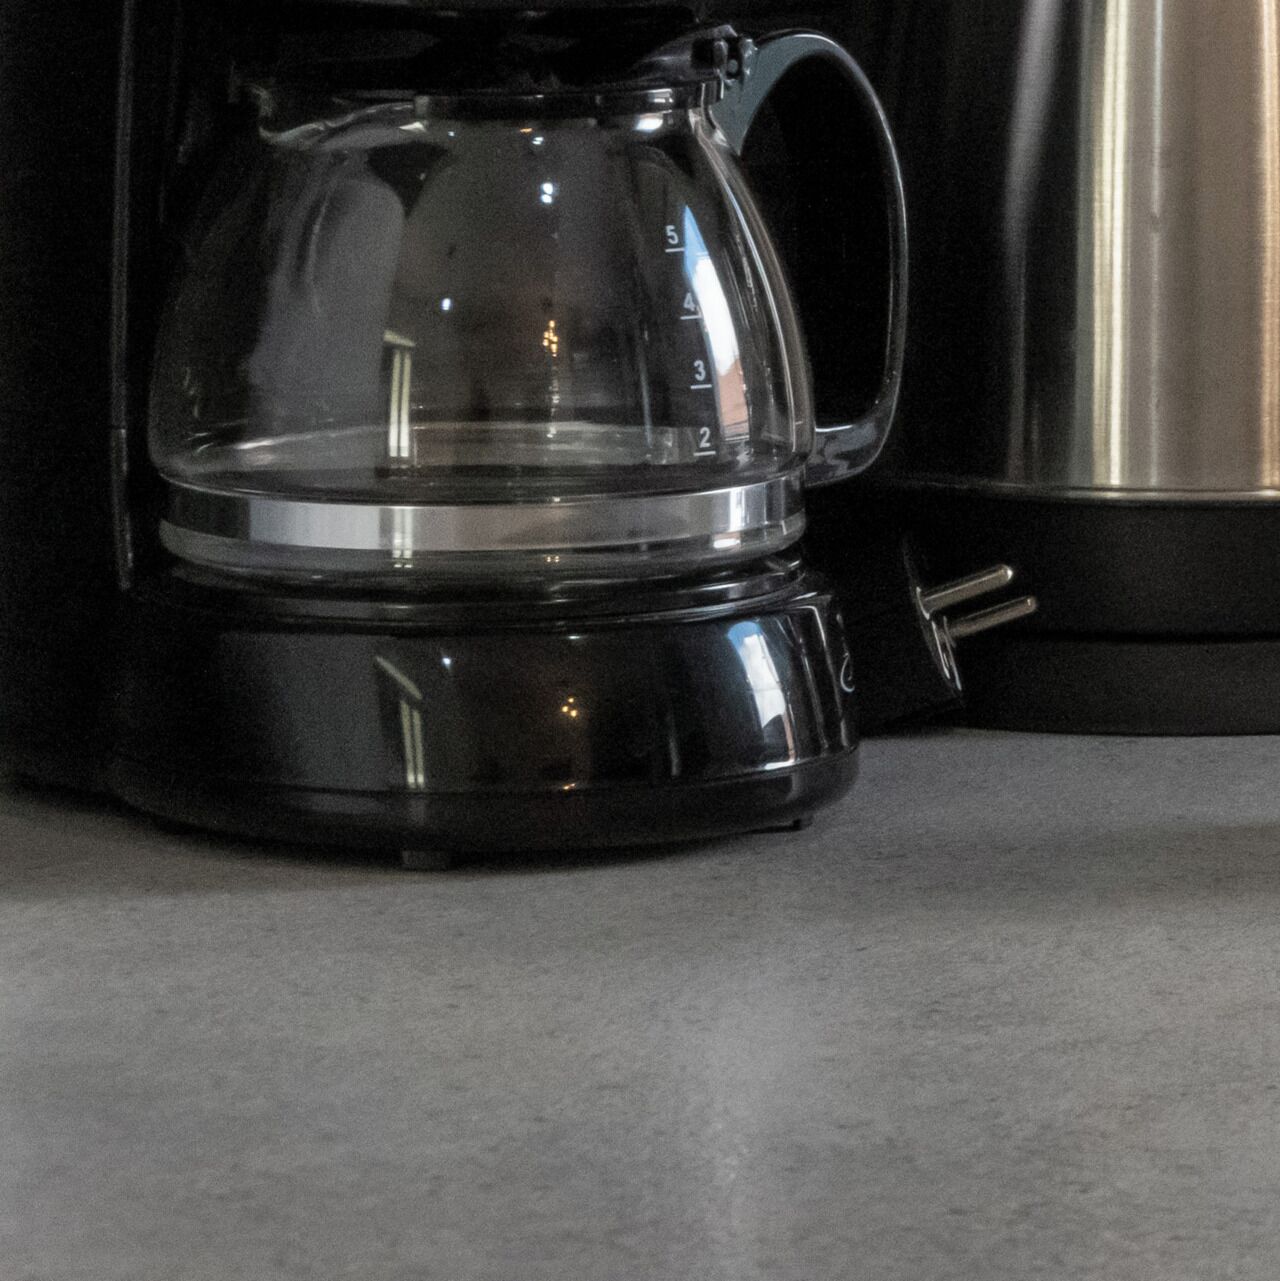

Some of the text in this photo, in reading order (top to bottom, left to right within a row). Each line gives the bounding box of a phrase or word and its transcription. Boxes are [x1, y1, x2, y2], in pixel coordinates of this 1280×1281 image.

[665, 224, 679, 245] 5
[683, 291, 697, 312] 4
[694, 360, 706, 381] 3
[700, 426, 711, 448] 2
